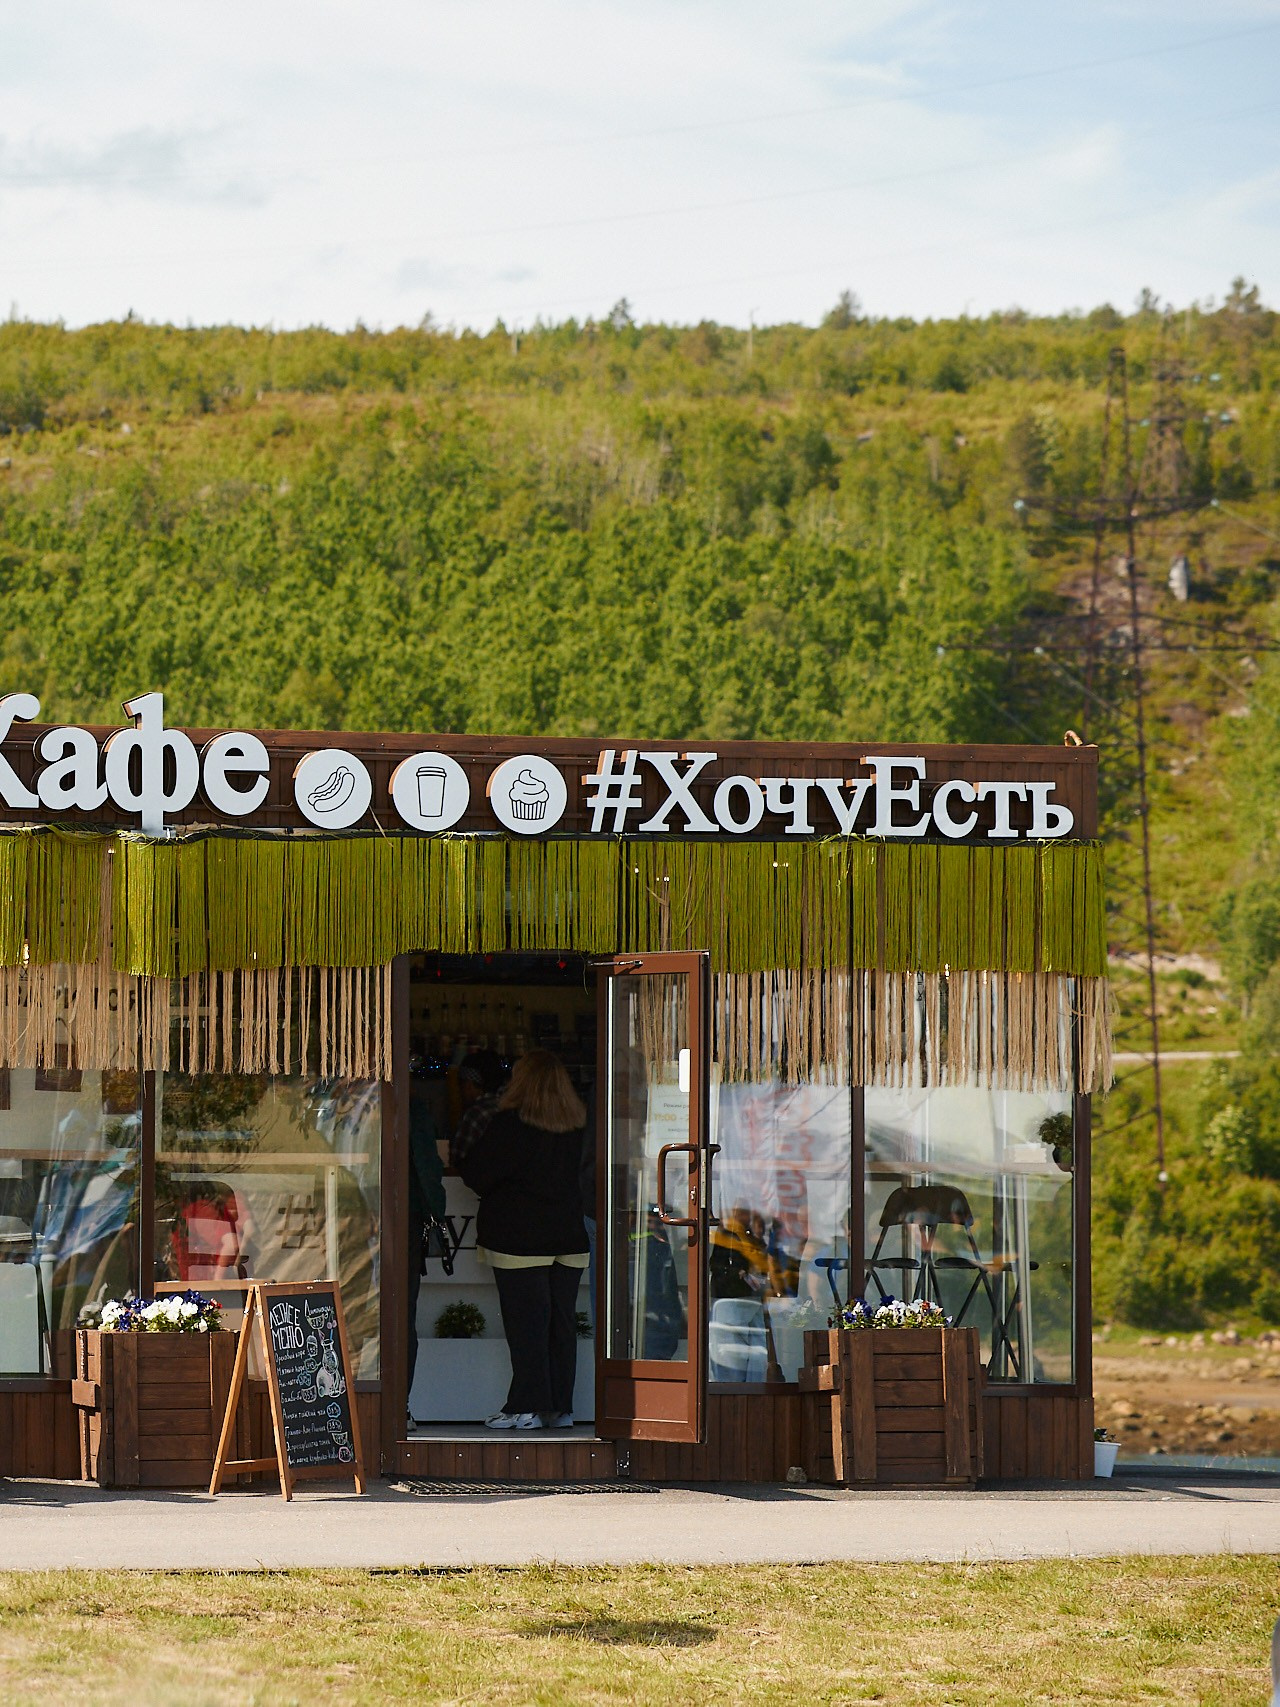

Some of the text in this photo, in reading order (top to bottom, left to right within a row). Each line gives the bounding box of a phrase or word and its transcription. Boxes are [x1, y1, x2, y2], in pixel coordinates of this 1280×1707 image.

[581, 749, 1075, 839] #ХочуЕсть
[269, 1302, 301, 1330] ЛЕТНЕЕ
[271, 1326, 304, 1351] МЕНЮ
